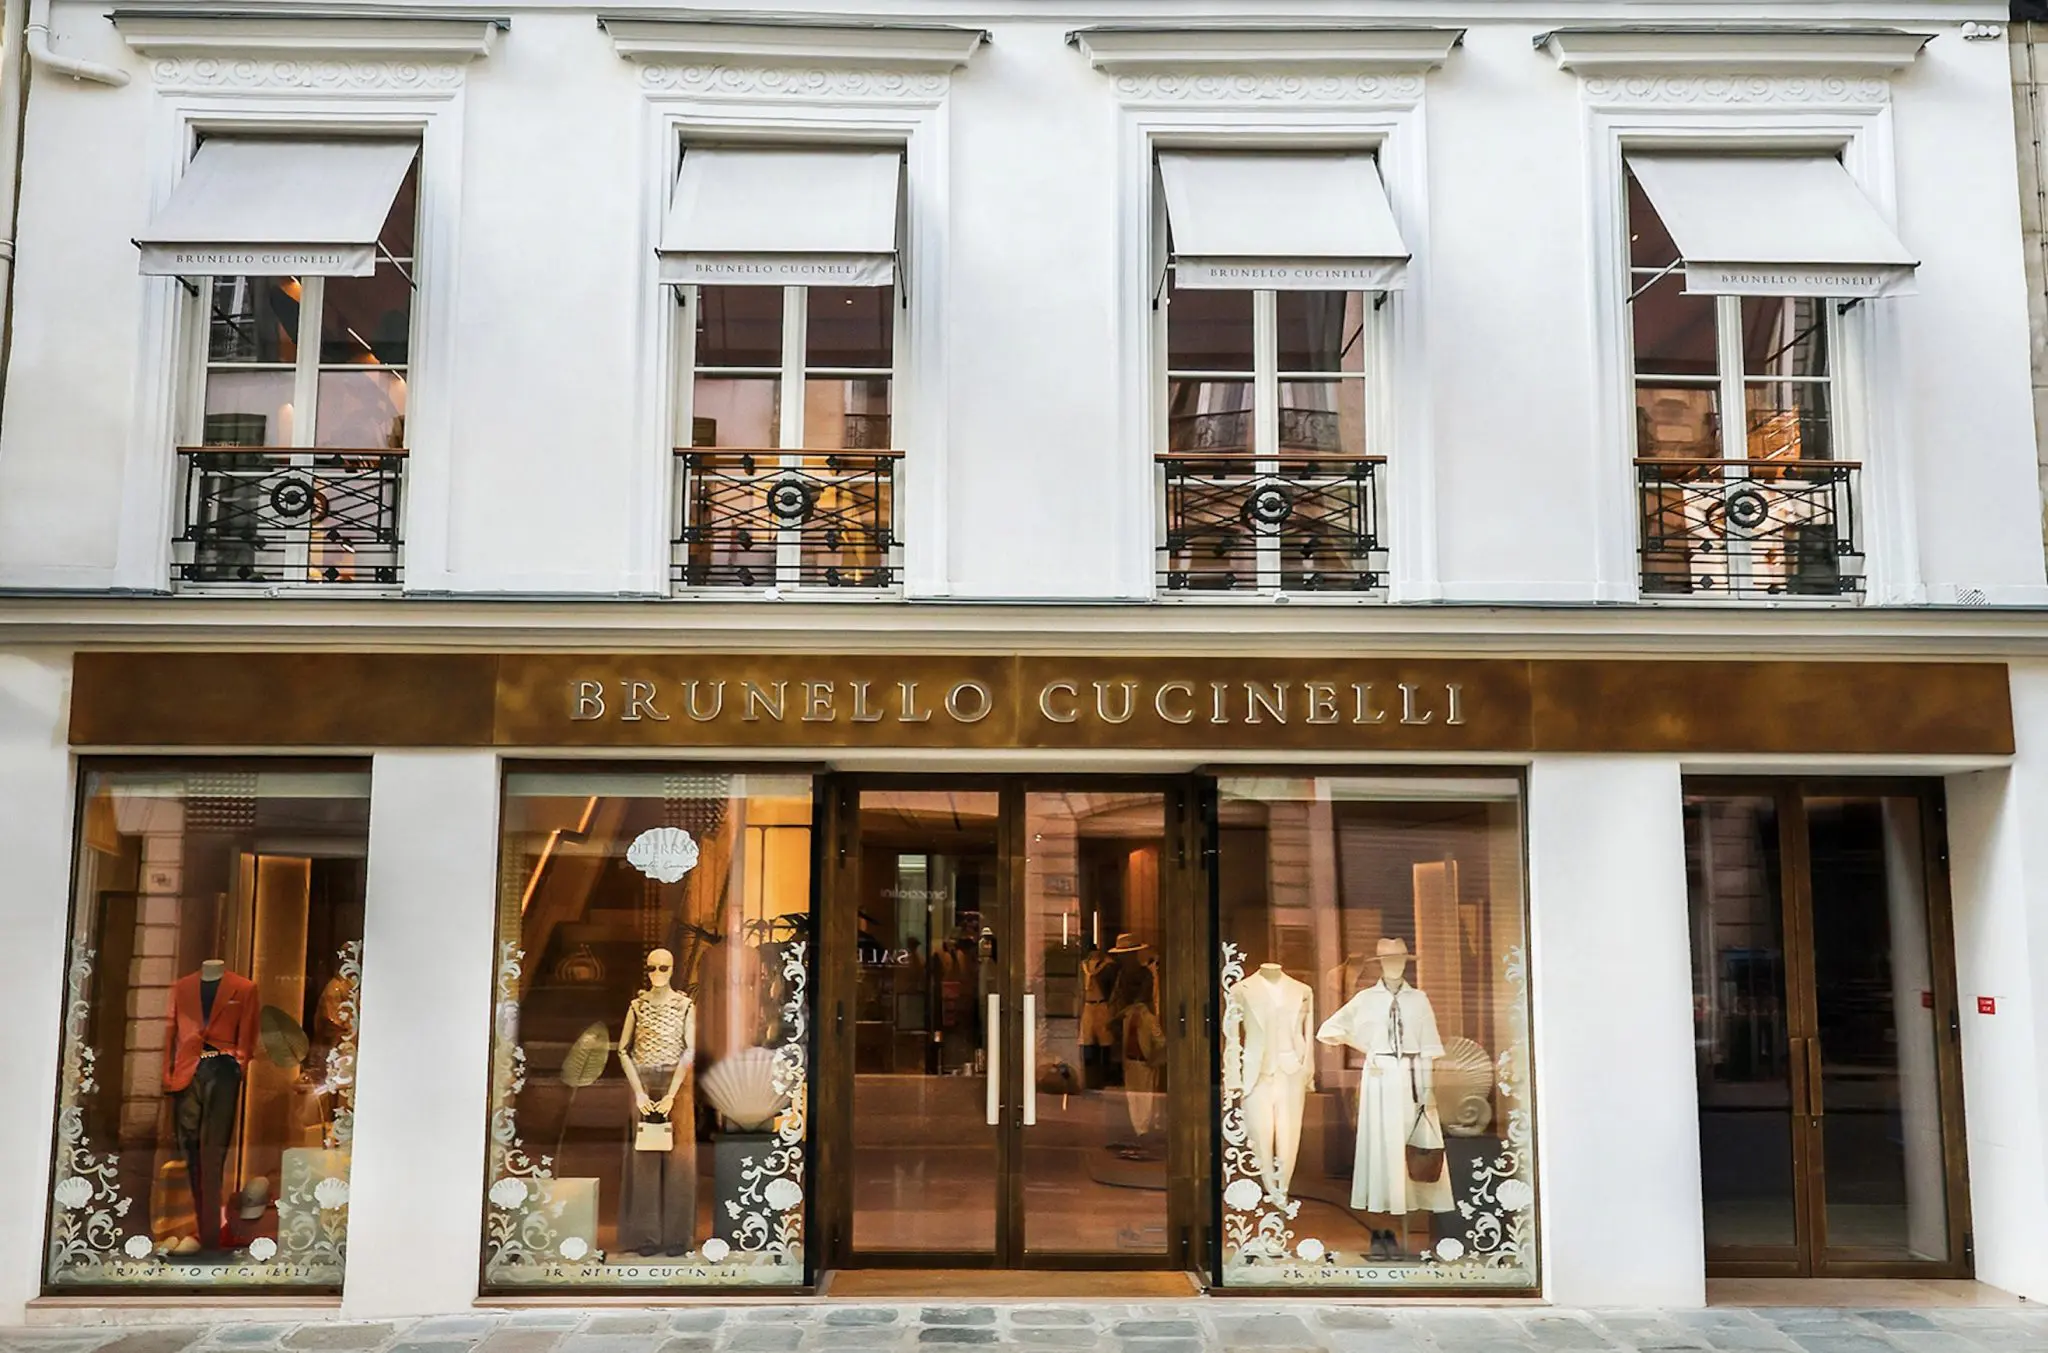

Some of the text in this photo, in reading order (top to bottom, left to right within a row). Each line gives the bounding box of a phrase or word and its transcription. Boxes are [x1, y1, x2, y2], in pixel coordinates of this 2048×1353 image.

[176, 254, 341, 264] BRUNELLO CUCINELLI
[695, 263, 858, 274] BRUNELLO CUCINELLI
[1210, 268, 1373, 278] BRUNELLO CUCINELLI
[1721, 274, 1882, 285] BRUNELLO CUCINELLI
[569, 679, 1467, 725] BRUNELLO CUCINELLI
